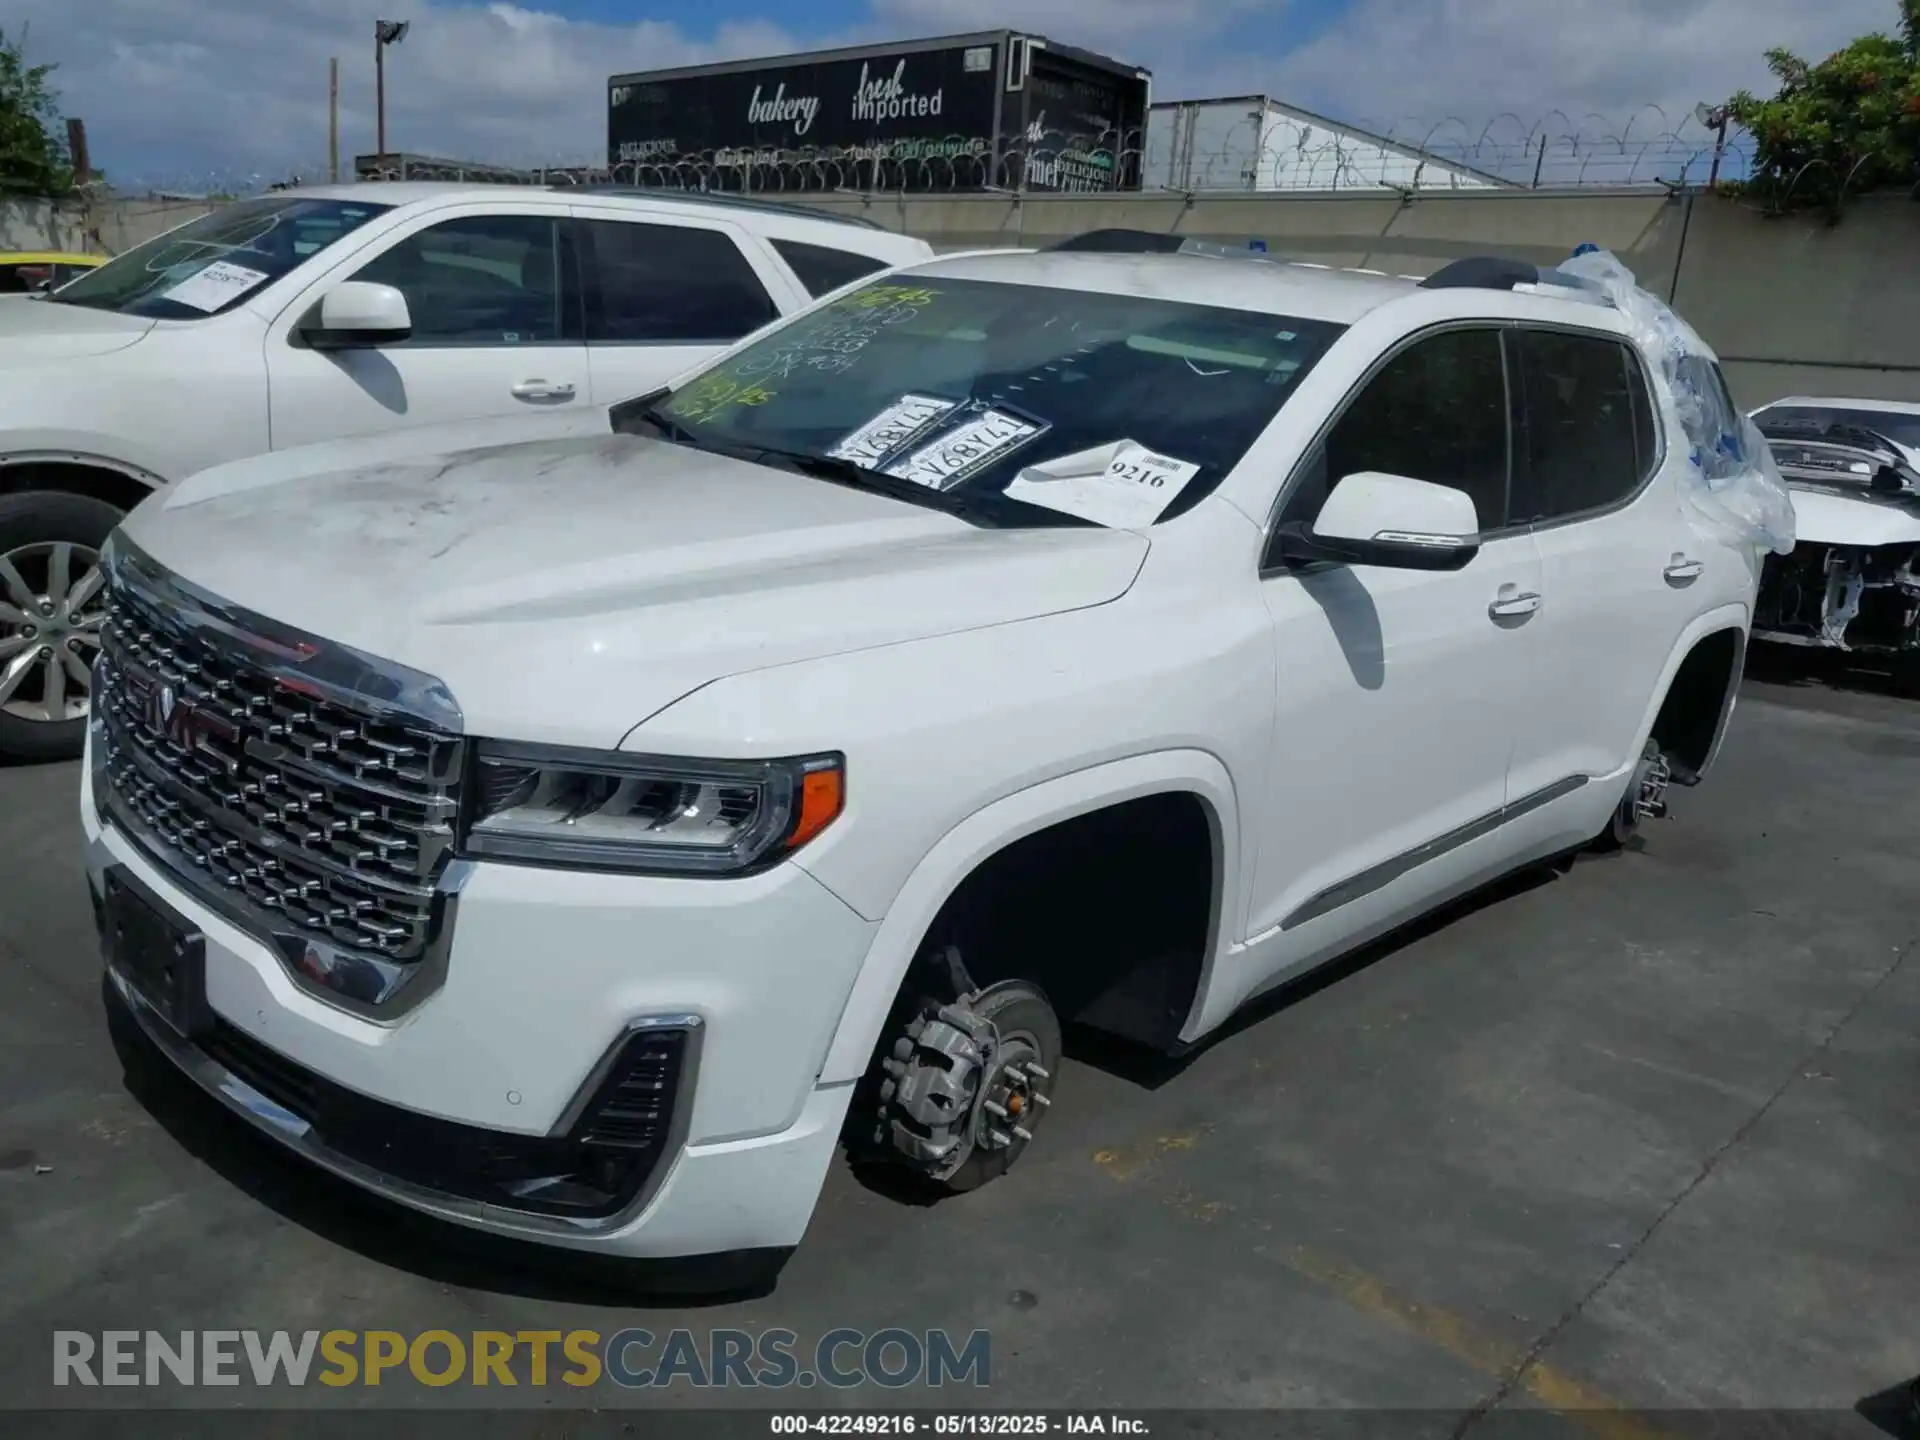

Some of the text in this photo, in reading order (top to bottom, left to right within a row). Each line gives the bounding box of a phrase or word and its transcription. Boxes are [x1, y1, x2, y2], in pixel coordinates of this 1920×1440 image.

[748, 83, 820, 135] bakery
[852, 88, 943, 124] imported
[850, 403, 943, 463] V68Y41
[1111, 461, 1169, 489] 9216
